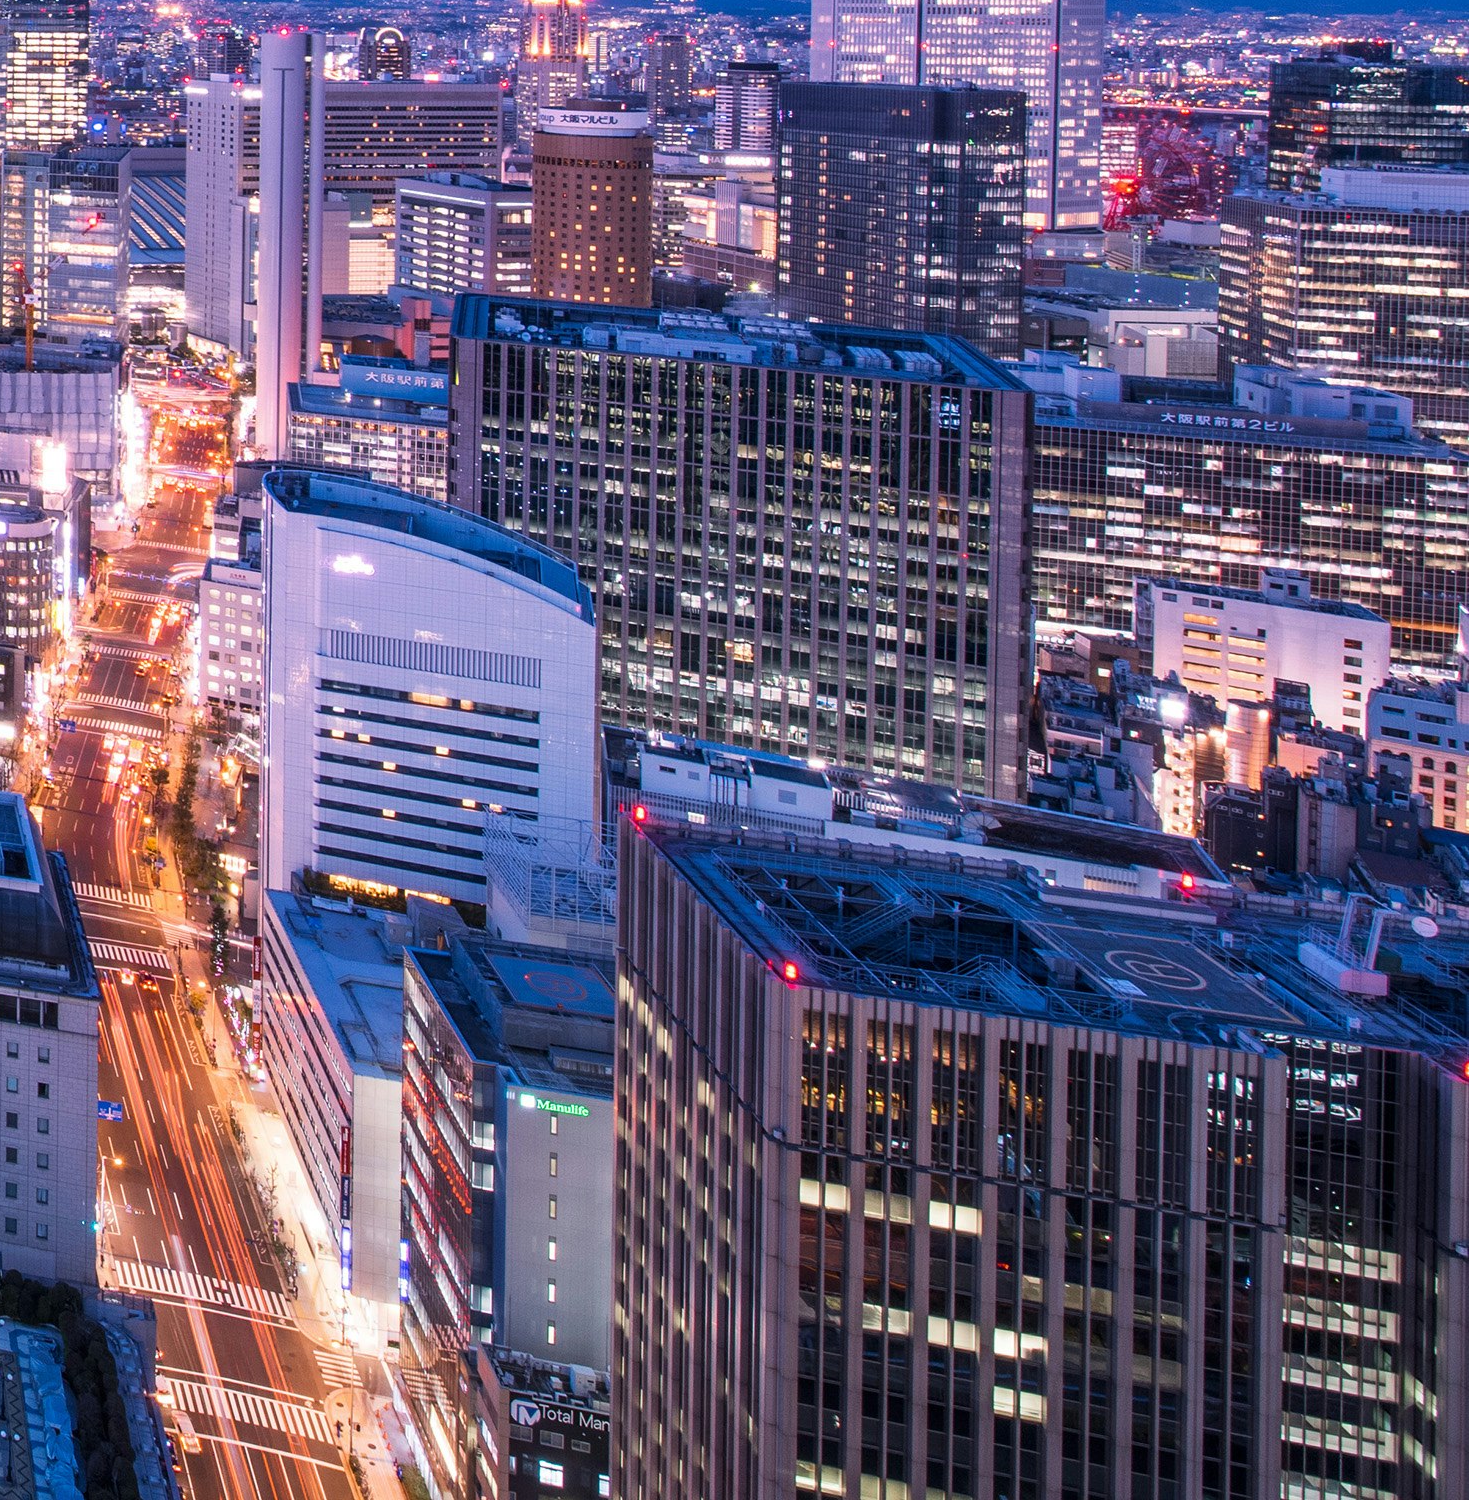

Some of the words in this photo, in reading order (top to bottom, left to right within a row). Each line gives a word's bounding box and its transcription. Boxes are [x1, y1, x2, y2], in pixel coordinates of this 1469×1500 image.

[560, 114, 619, 125] 大阪マルビル
[365, 372, 445, 389] 大阪駅前第
[1161, 412, 1295, 433] 大阪駅前第2ビル
[536, 1099, 590, 1117] Manulife
[539, 1403, 574, 1425] Total
